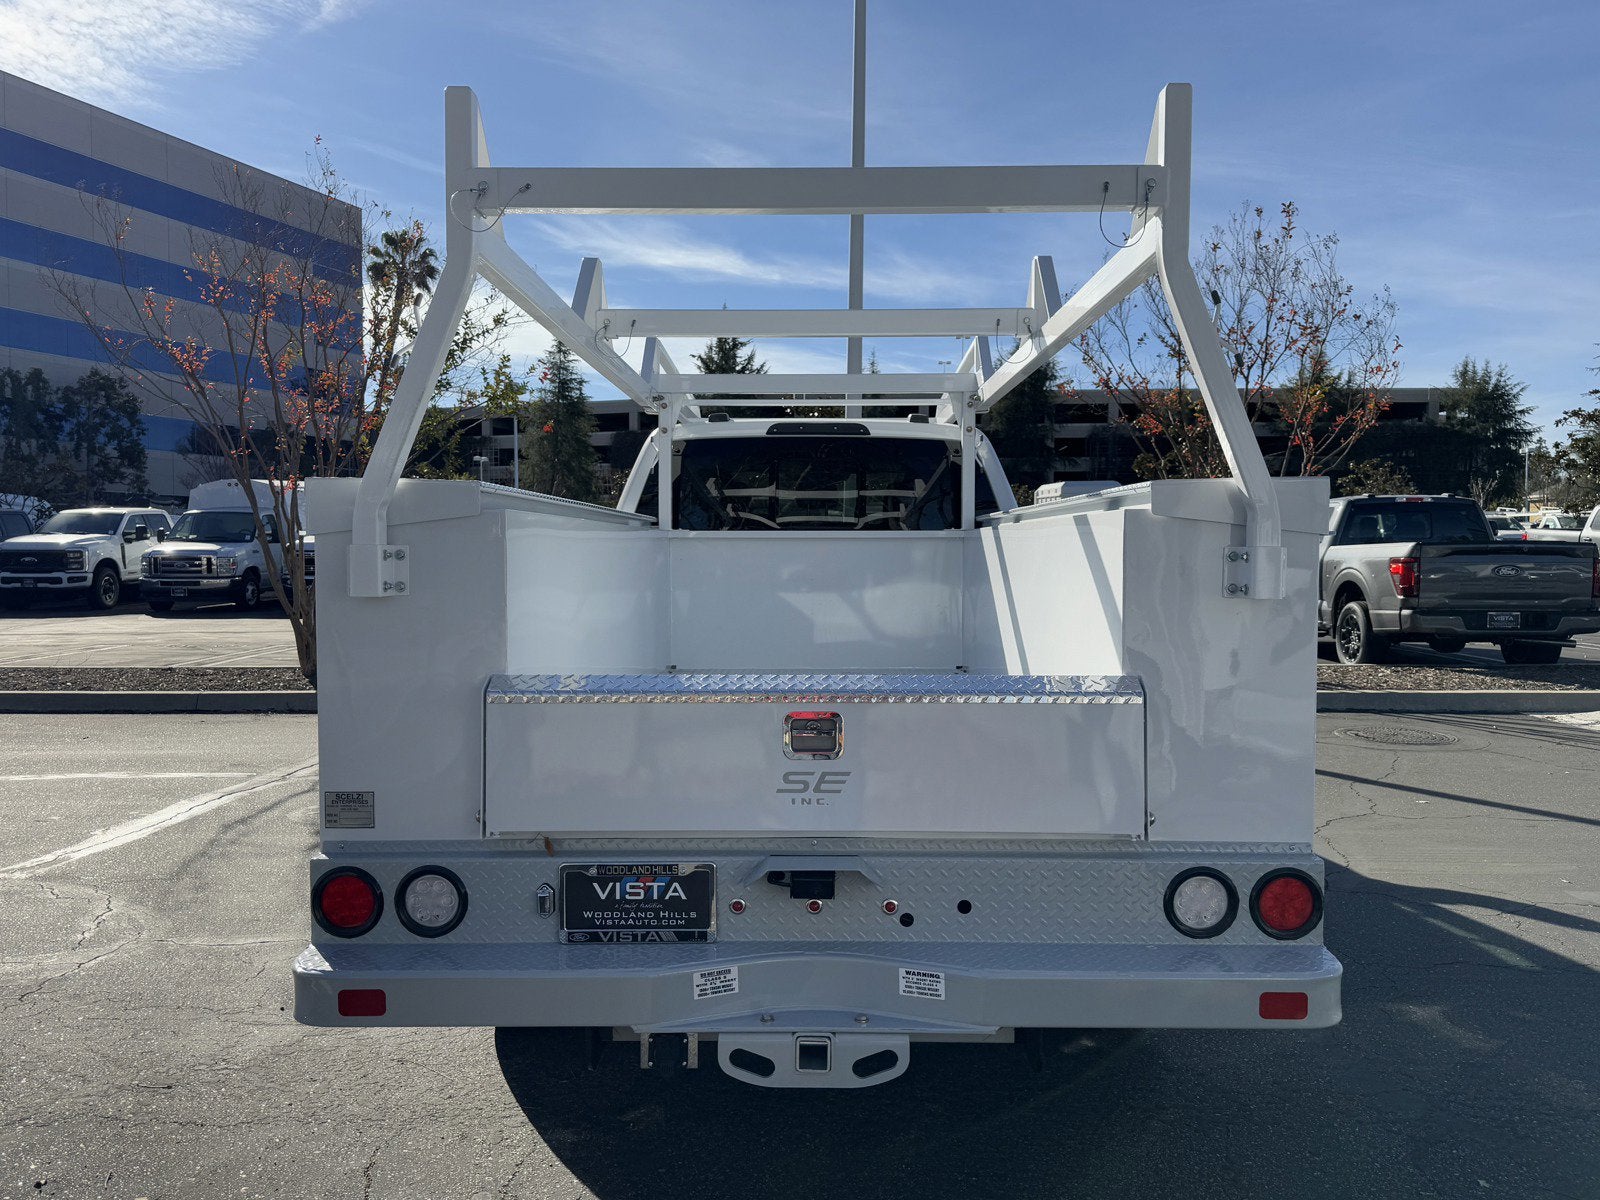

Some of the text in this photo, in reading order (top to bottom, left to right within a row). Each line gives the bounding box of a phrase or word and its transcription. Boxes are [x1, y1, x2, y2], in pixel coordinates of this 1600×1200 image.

[776, 771, 852, 794] SE
[791, 797, 829, 806] INC.
[598, 865, 678, 875] WOODLAND HILLS
[592, 882, 687, 900] VISTA
[660, 910, 697, 918] HILLS
[598, 931, 661, 942] VISTA
[904, 969, 941, 979] WARNING
